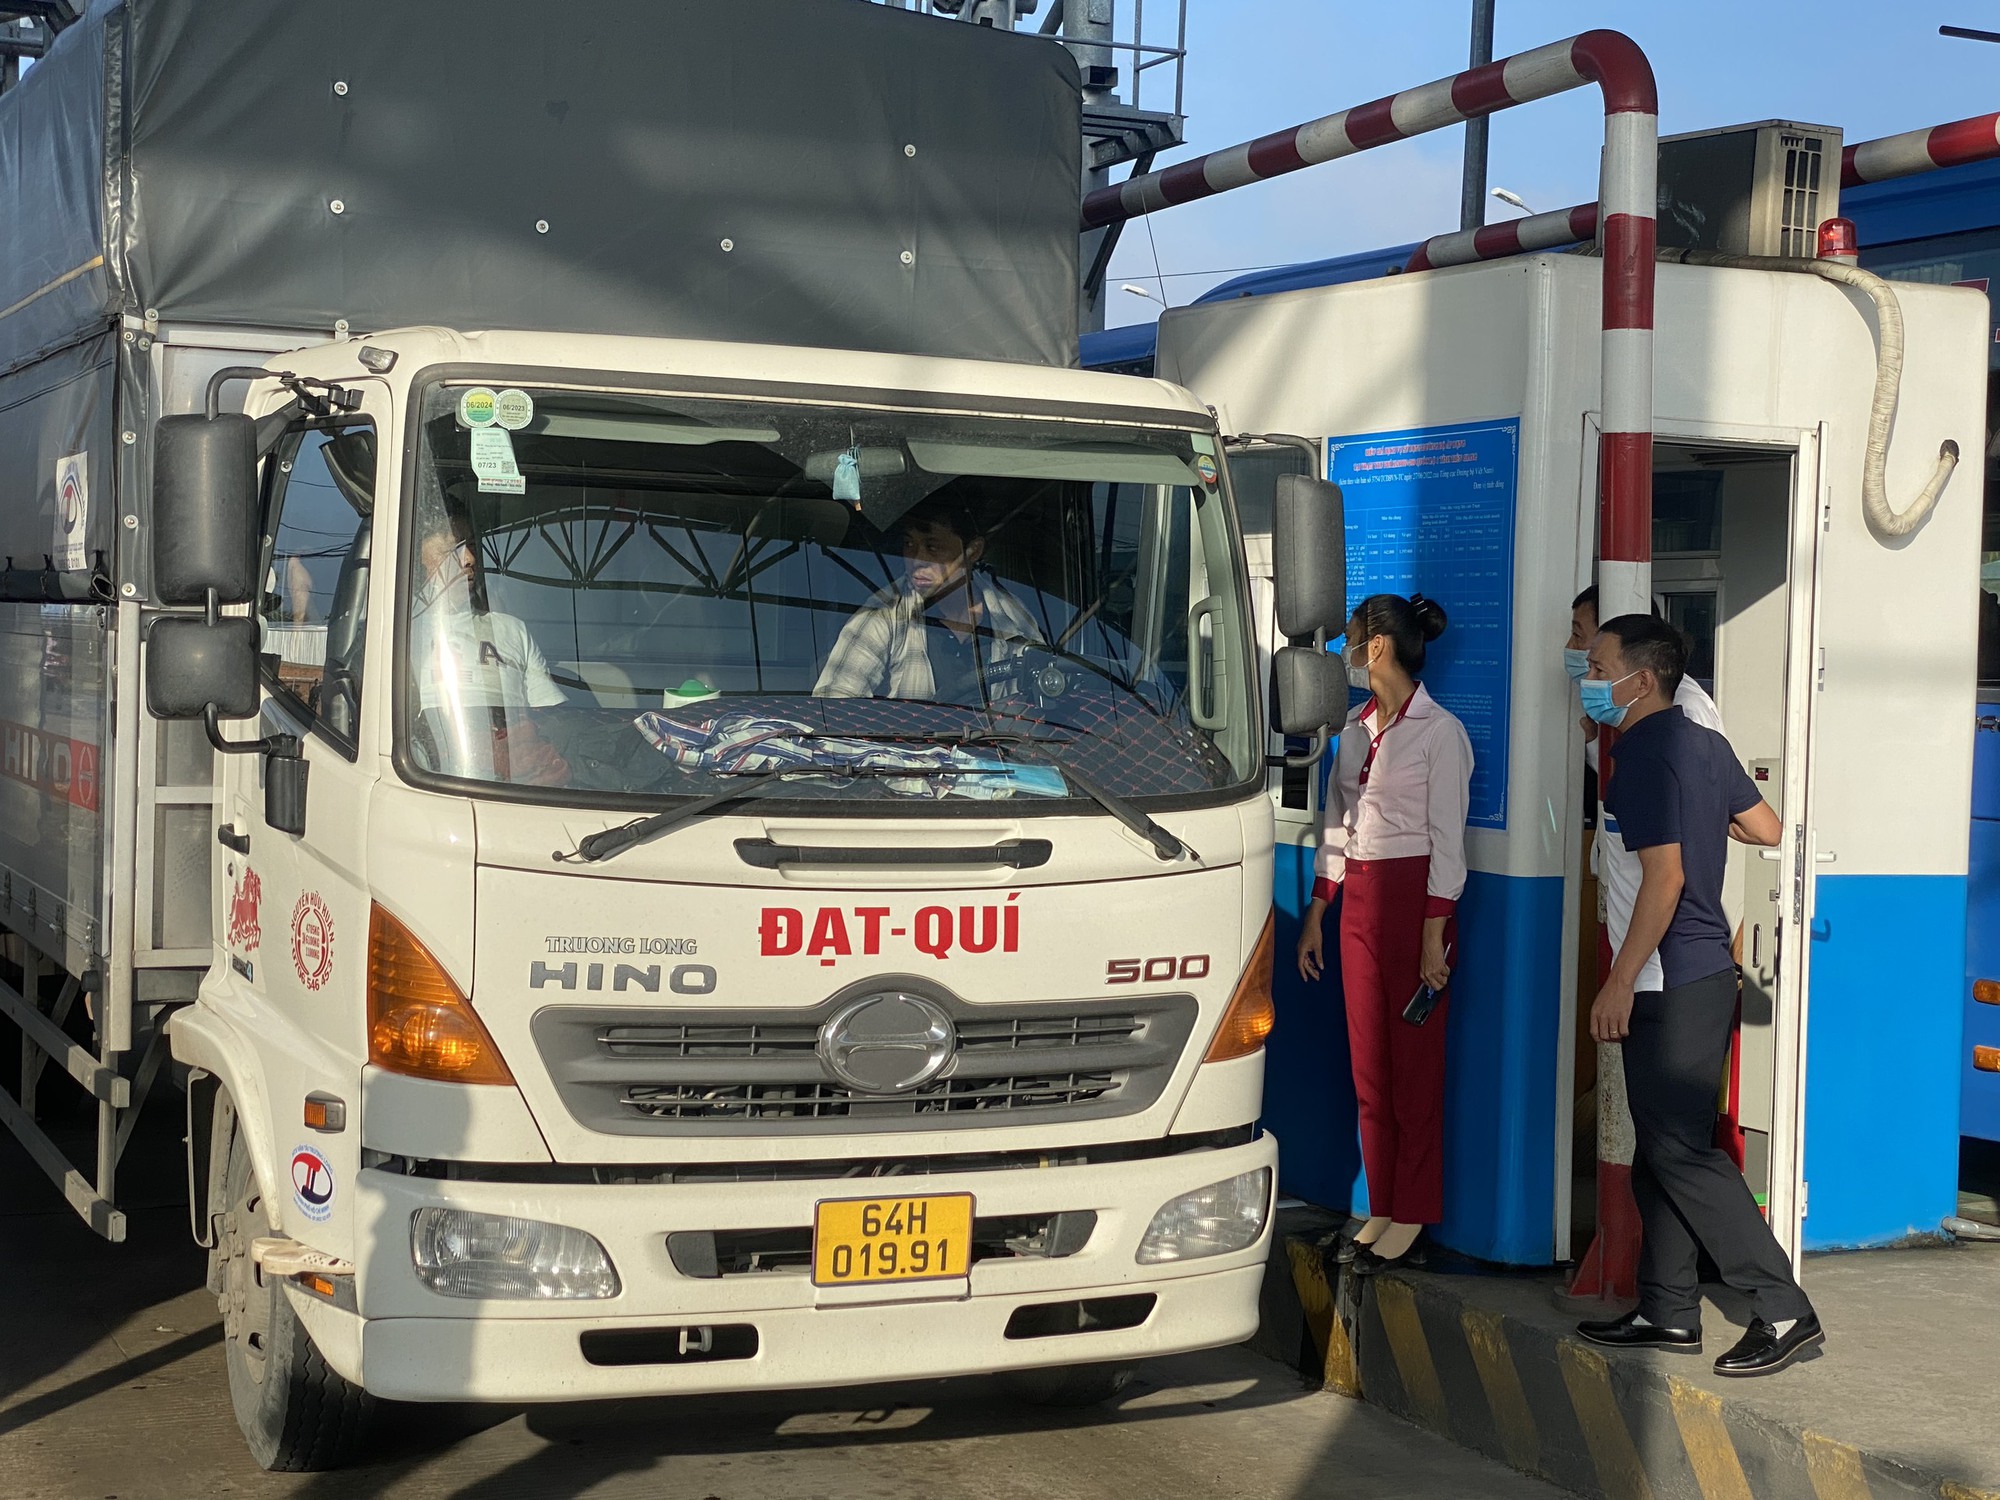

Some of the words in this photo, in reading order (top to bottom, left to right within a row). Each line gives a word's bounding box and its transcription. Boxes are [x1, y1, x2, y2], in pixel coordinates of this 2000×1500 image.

[466, 401, 493, 409] 06/2024
[502, 404, 525, 412] 06/2023
[4, 726, 72, 794] HINO
[291, 888, 309, 931] NGUYỄN
[546, 936, 635, 954] TRUONG
[639, 937, 698, 955] LONG
[758, 892, 1021, 967] ĐẠT-QUÍ
[306, 977, 320, 991] 546
[321, 959, 333, 986] 453
[530, 961, 717, 995] HINO
[1104, 954, 1210, 985] 500
[862, 1201, 927, 1237] 64H
[832, 1238, 948, 1278] 019.91
